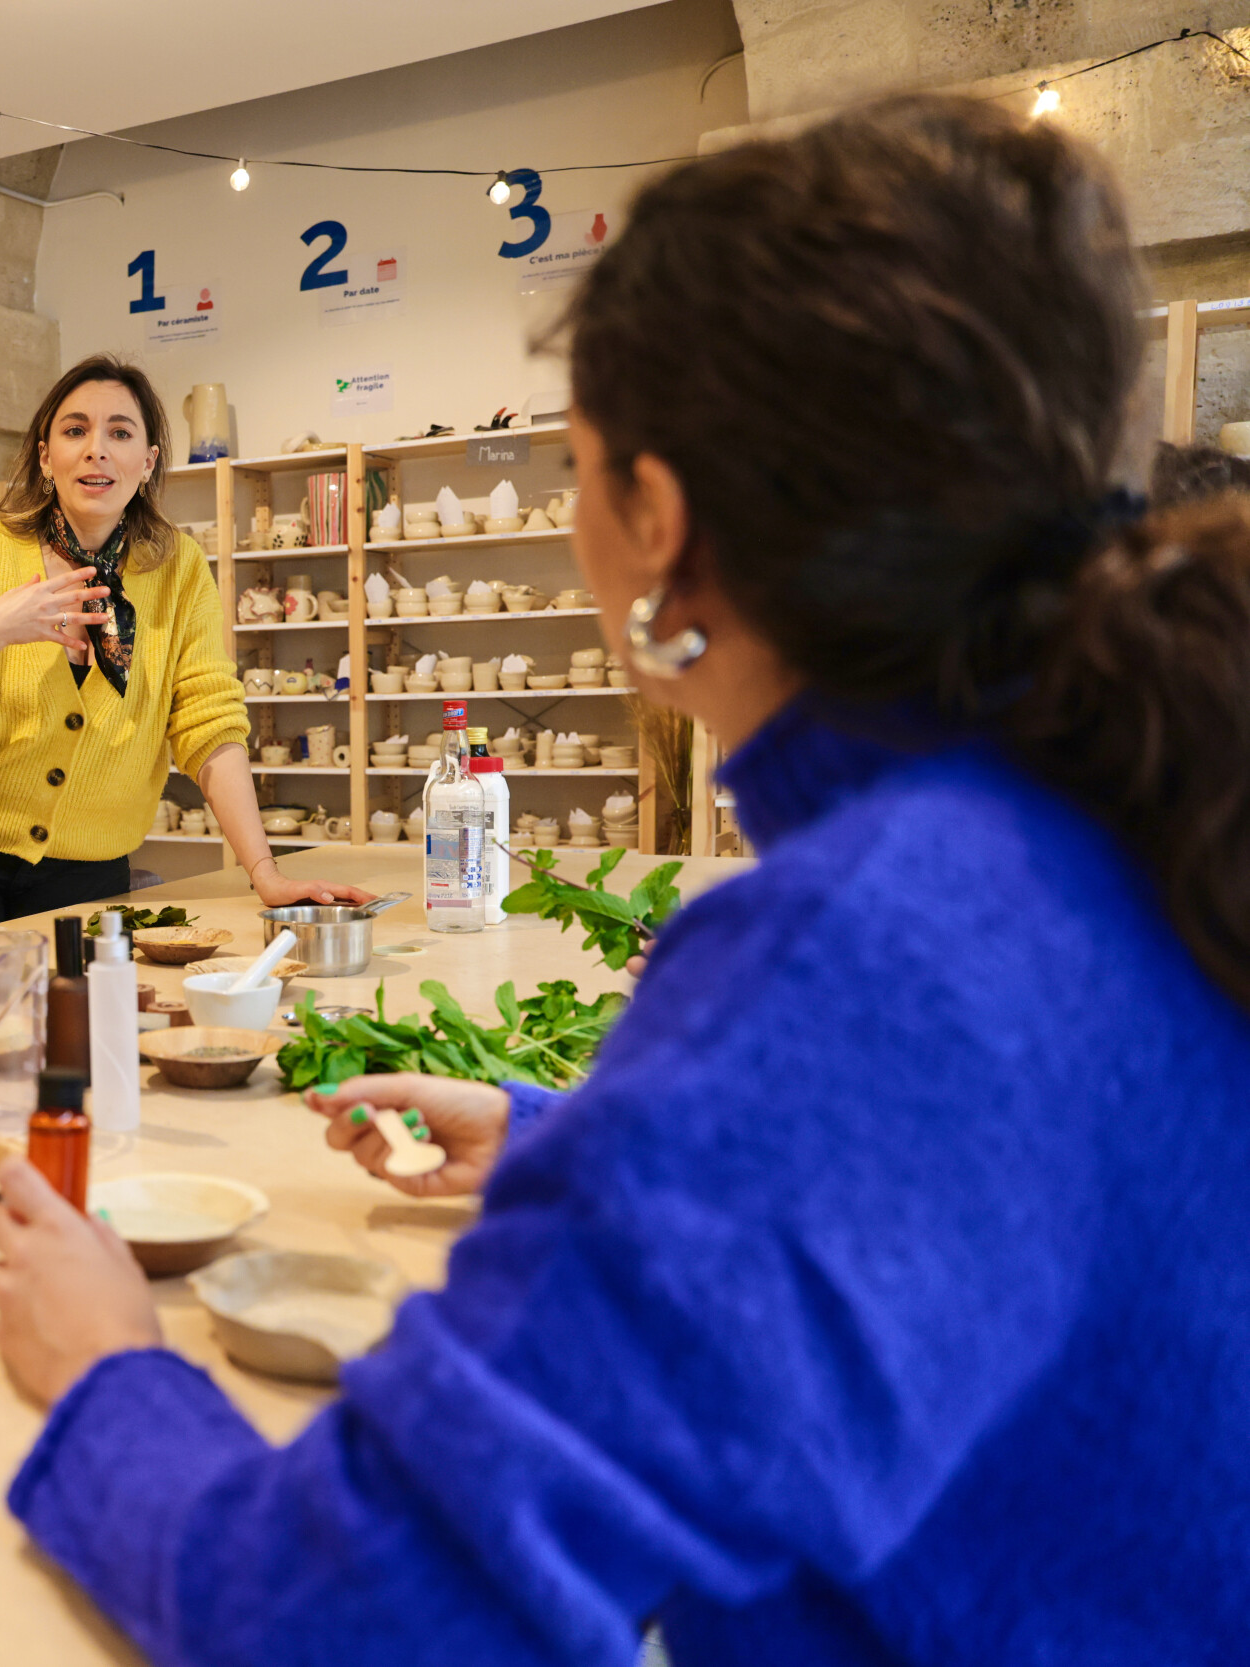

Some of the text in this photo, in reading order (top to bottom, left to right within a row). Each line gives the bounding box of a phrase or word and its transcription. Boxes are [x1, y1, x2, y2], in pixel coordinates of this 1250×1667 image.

[486, 168, 551, 259] 3
[300, 220, 348, 291] 2
[529, 254, 553, 264] C'est
[128, 250, 165, 314] 1
[359, 287, 380, 295] date
[171, 315, 209, 325] céramiste
[351, 374, 390, 383] Attention
[356, 383, 384, 391] fragile
[479, 446, 515, 461] Marina
